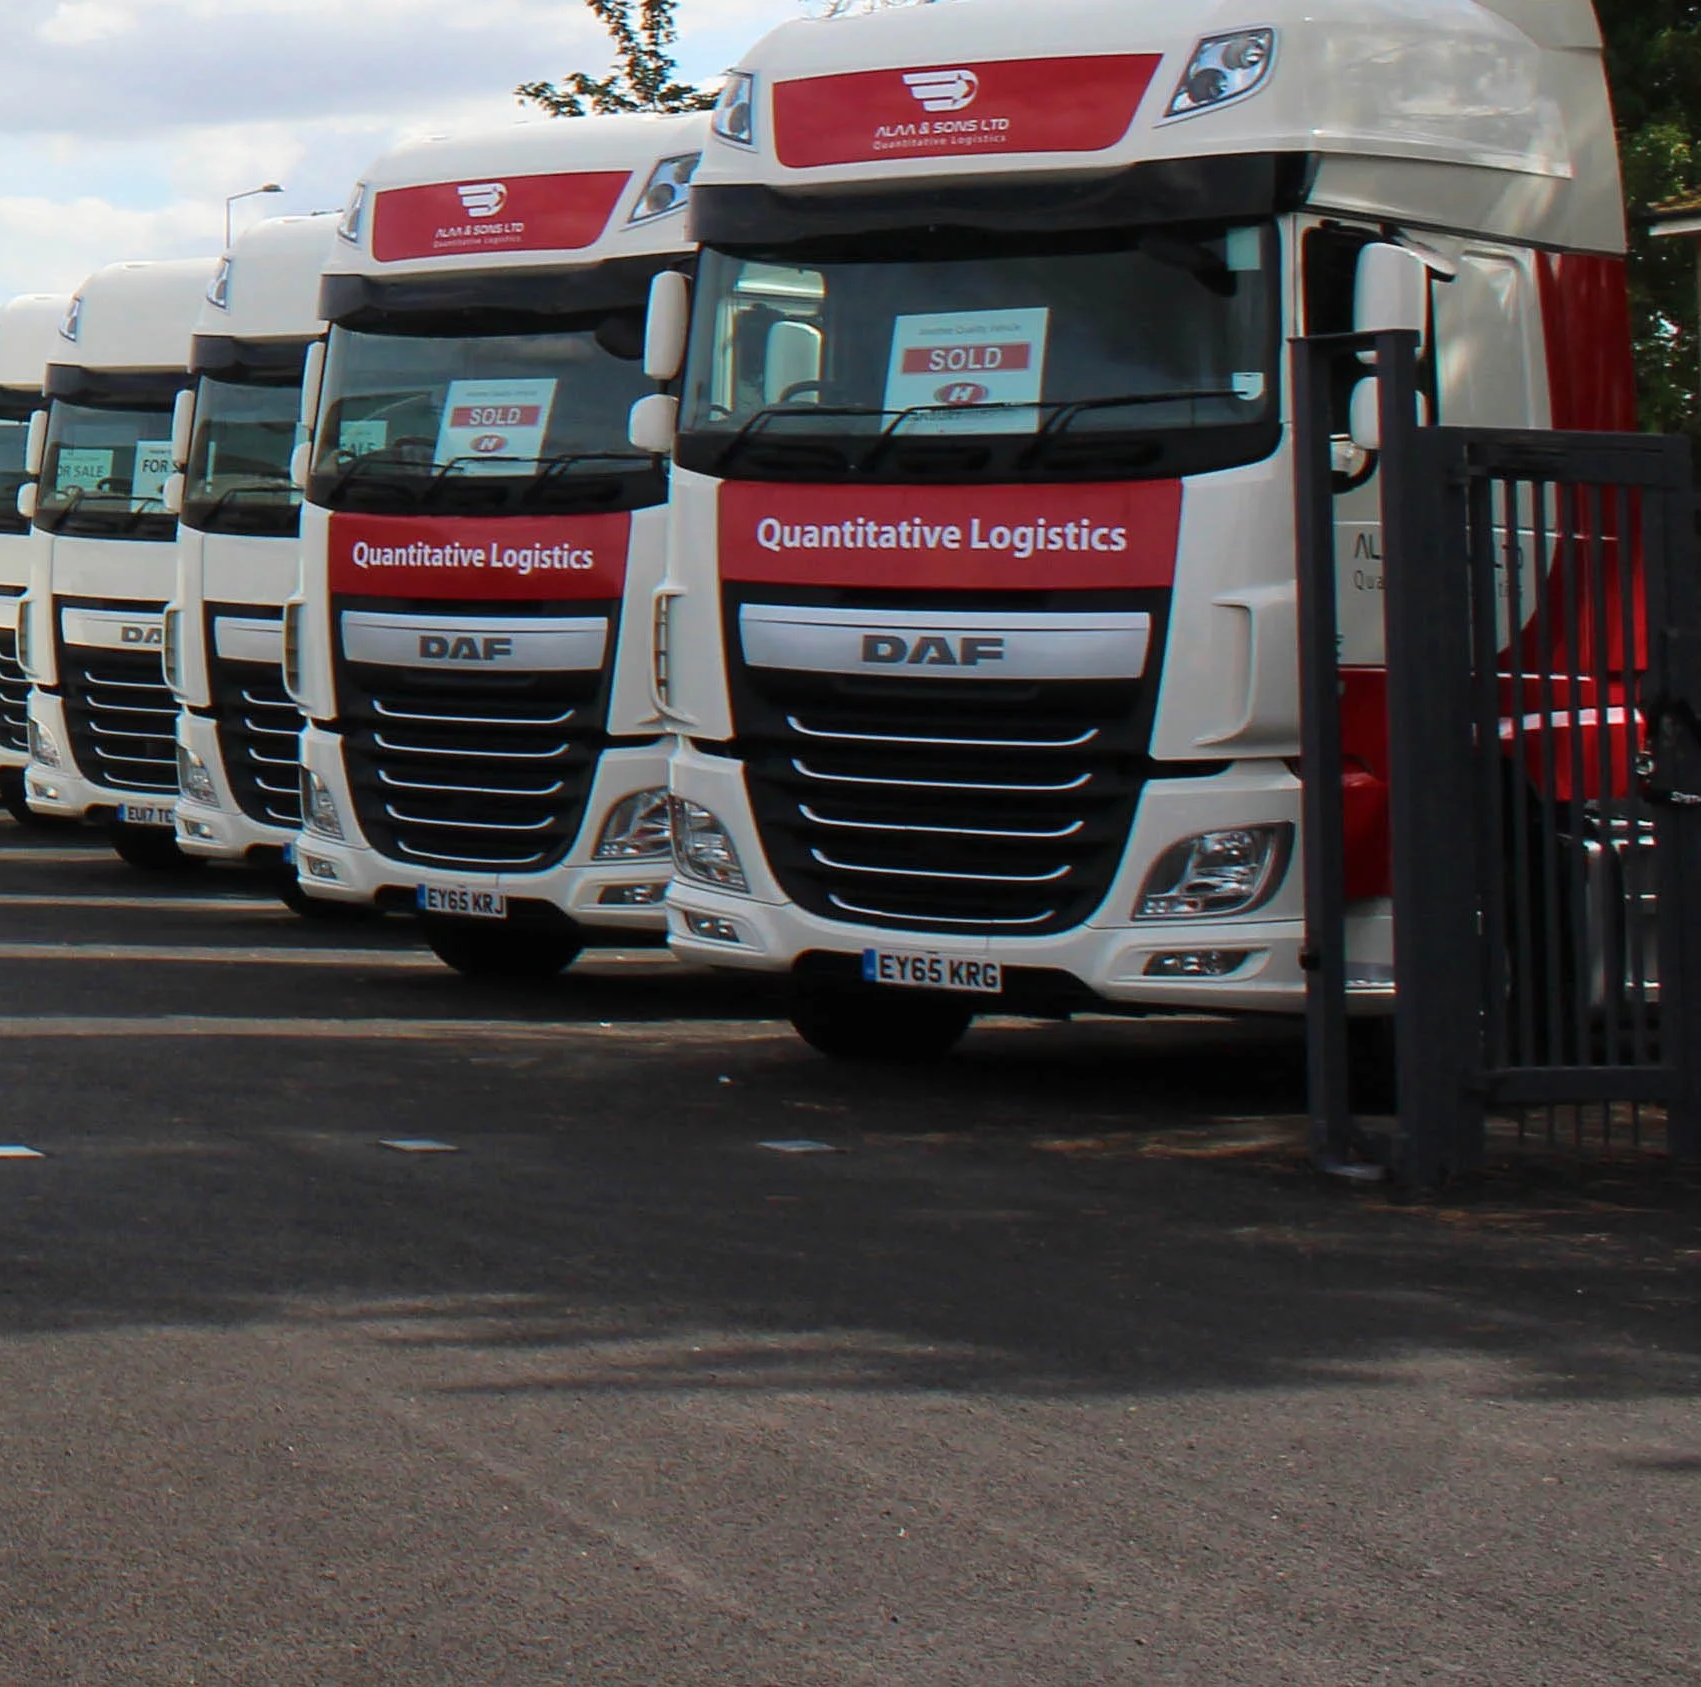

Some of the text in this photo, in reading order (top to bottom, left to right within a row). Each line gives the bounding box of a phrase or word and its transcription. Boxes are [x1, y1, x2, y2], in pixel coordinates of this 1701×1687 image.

[918, 121, 930, 135] &
[933, 119, 978, 134] SONS
[980, 117, 1010, 131] LTD
[872, 134, 1007, 151] Quantitative Logistics
[473, 223, 504, 236] SONS
[504, 222, 526, 233] LTD
[928, 346, 1003, 372] SOLD
[468, 407, 522, 426] SOLD
[73, 464, 104, 478] SALE
[142, 458, 168, 473] FOR
[756, 516, 1128, 559] Quantitative Logistics
[352, 541, 594, 575] Quantitative Logistics
[121, 626, 163, 644] DA
[419, 635, 513, 661] DAF
[861, 634, 1005, 666] DAF
[428, 887, 504, 914] EY65 KRJ
[879, 953, 998, 988] EY65 KRG
